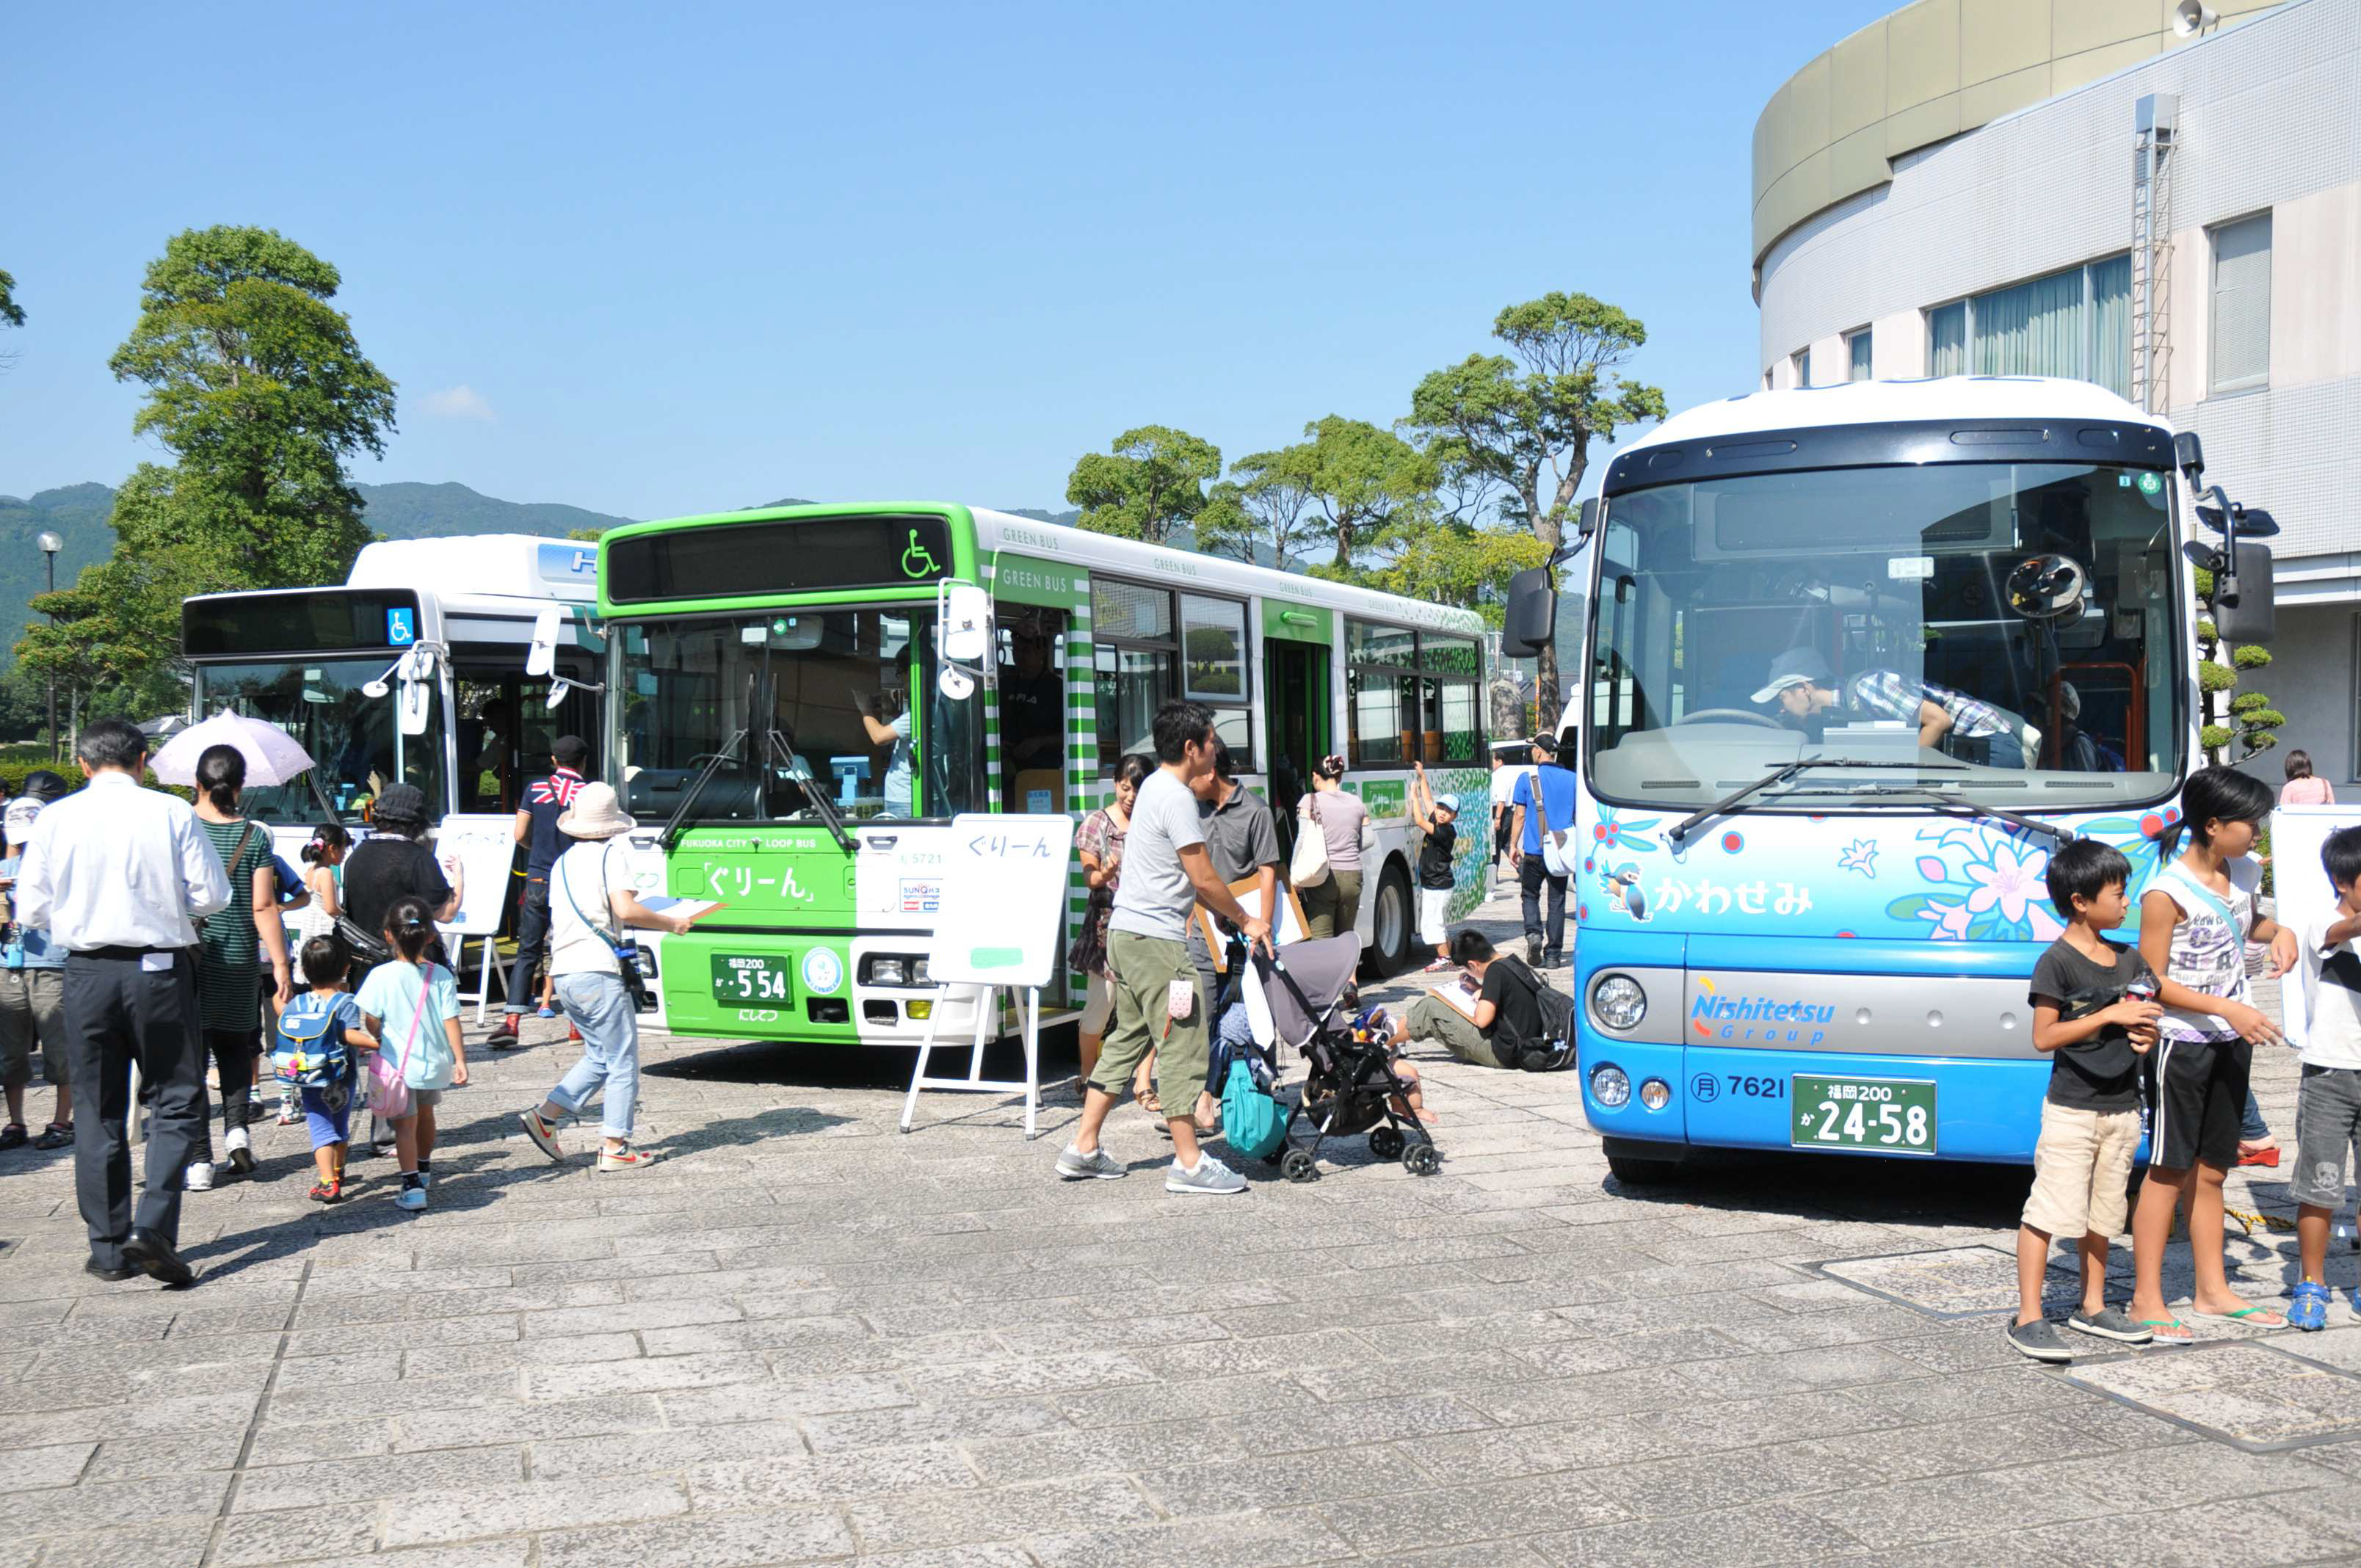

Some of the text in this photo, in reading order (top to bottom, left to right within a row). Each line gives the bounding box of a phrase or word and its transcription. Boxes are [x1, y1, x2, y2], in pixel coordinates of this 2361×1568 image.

[1003, 528, 1059, 550] GREEN BUS
[1154, 558, 1197, 576] GREEN BUS
[1003, 569, 1067, 593] GREEN BUS
[681, 839, 816, 849] FUKUOKA CITY LOOP BUS
[968, 835, 1051, 857] ぐりーん
[913, 853, 942, 864] 5721
[1654, 878, 1813, 916] かわせみ
[728, 958, 764, 969] 福岡200
[739, 1009, 778, 1022] にしてつ
[1691, 995, 1835, 1023] Nishitetsu
[1720, 1024, 1824, 1046] Group
[1727, 1075, 1784, 1098] 7621
[1827, 1084, 1892, 1102] 福岡200
[1800, 1101, 1927, 1145] か 24-58
